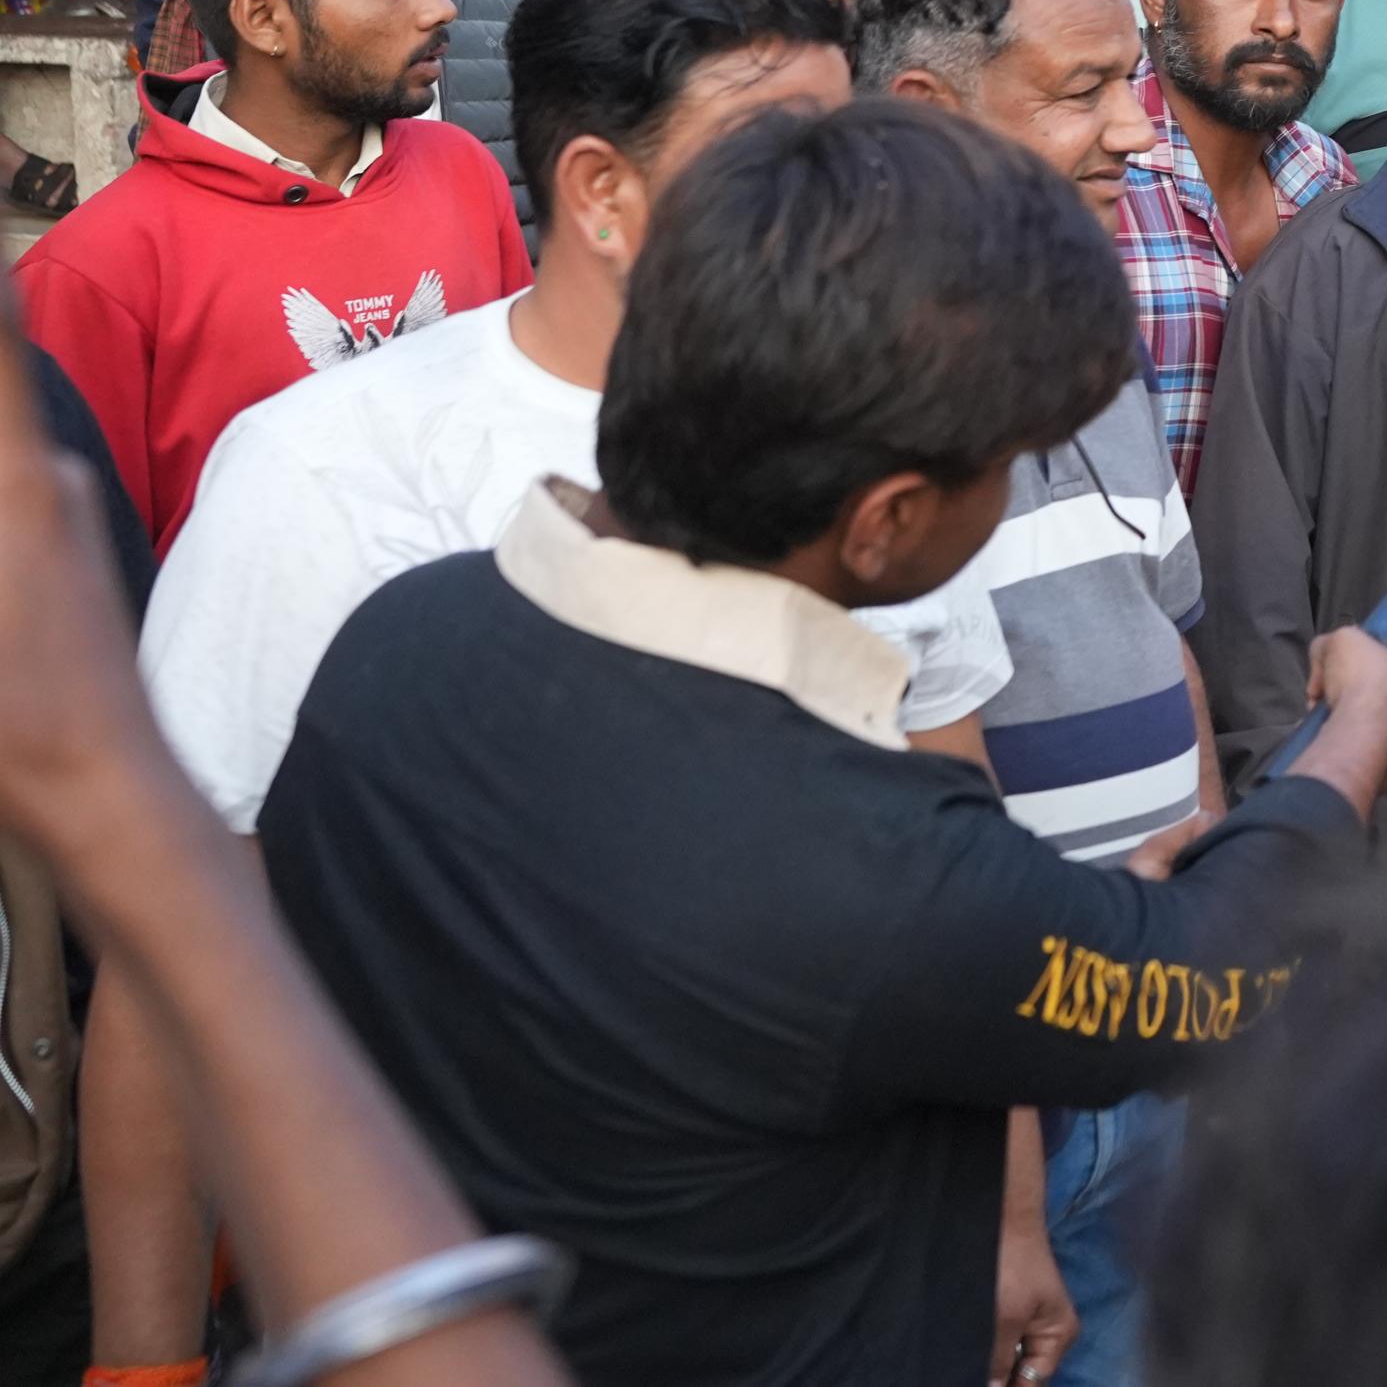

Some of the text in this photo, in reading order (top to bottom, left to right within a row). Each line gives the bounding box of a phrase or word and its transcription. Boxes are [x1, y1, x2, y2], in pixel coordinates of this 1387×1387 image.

[344, 294, 394, 313] TOMMY
[353, 309, 391, 324] JEANS
[1136, 958, 1246, 1042] POLO
